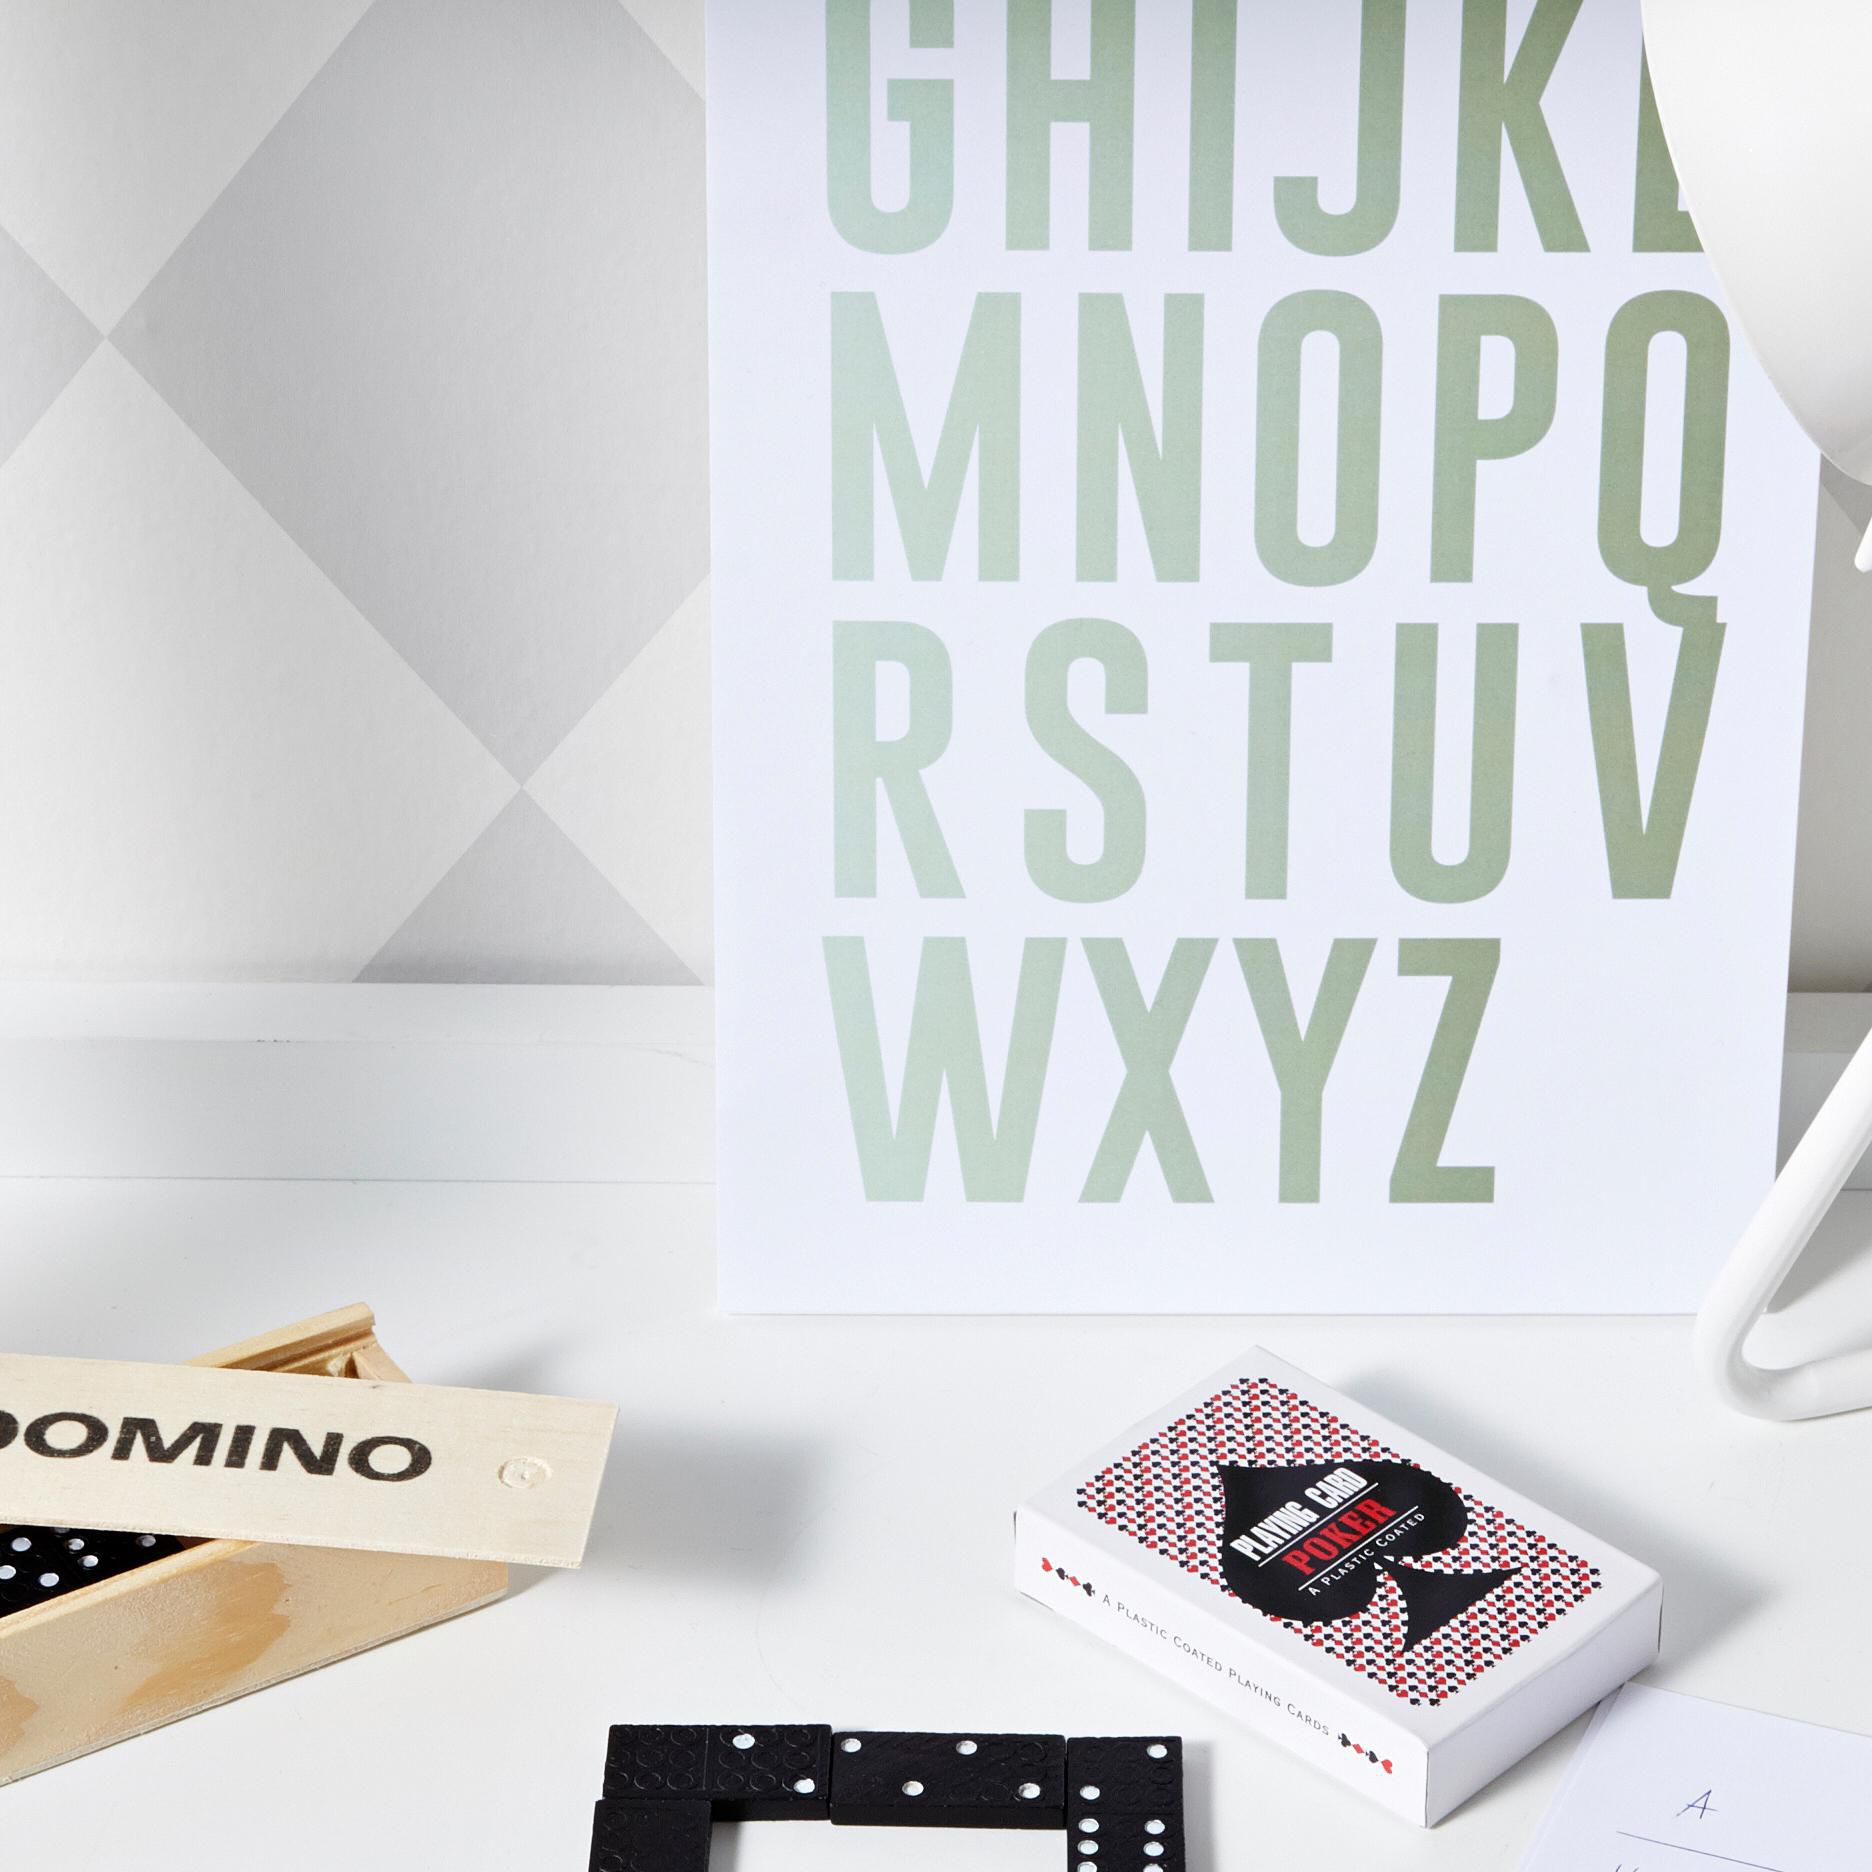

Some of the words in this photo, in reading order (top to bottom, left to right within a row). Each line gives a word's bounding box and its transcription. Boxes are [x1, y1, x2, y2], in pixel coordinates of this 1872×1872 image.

[829, 288, 1731, 628] MNOPQ
[830, 616, 1728, 904] RSTUV
[821, 935, 1502, 1204] WXYZ
[1229, 1500, 1321, 1561] PLAYING
[1304, 1467, 1369, 1509] CARD
[1280, 1498, 1397, 1576] POKER
[1307, 1586, 1321, 1597] A
[1320, 1548, 1375, 1586] PLASTIC
[1375, 1512, 1426, 1548] COATED
[1102, 1594, 1111, 1606] A
[1117, 1601, 1168, 1640] PLASTIC
[1173, 1636, 1223, 1672] COATED
[1228, 1668, 1281, 1707] PLAYING
[1287, 1703, 1329, 1735] CARDS
[1674, 1789, 1719, 1819] A
